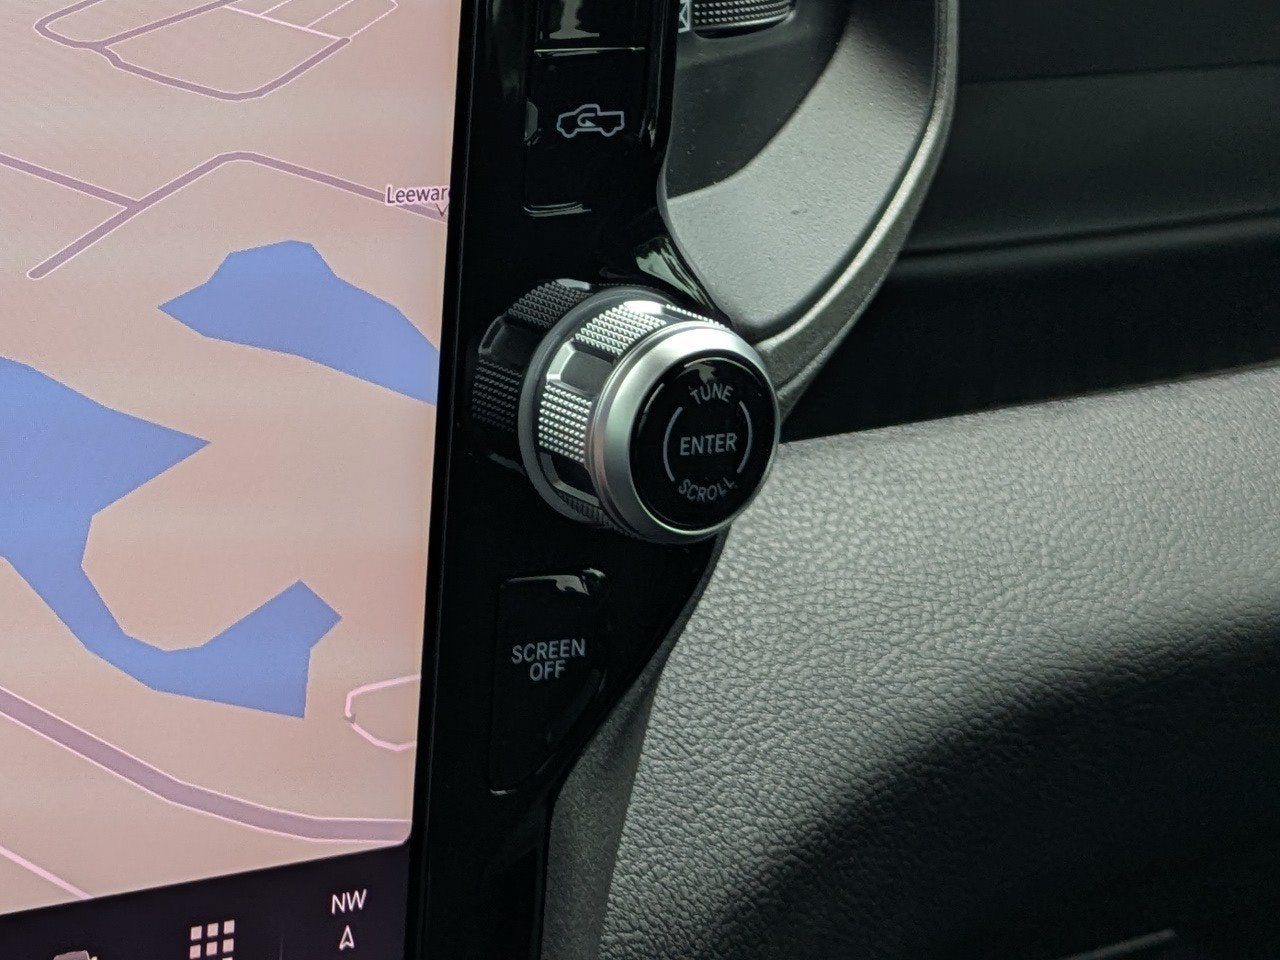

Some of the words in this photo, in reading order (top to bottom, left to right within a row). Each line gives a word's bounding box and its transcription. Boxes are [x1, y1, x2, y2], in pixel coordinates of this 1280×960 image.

[689, 382, 734, 405] TUNE
[679, 433, 738, 457] ENTER
[678, 477, 735, 502] SCROLL
[510, 638, 587, 665] SCREEN
[529, 659, 567, 682] OFF
[331, 888, 368, 915] NW
